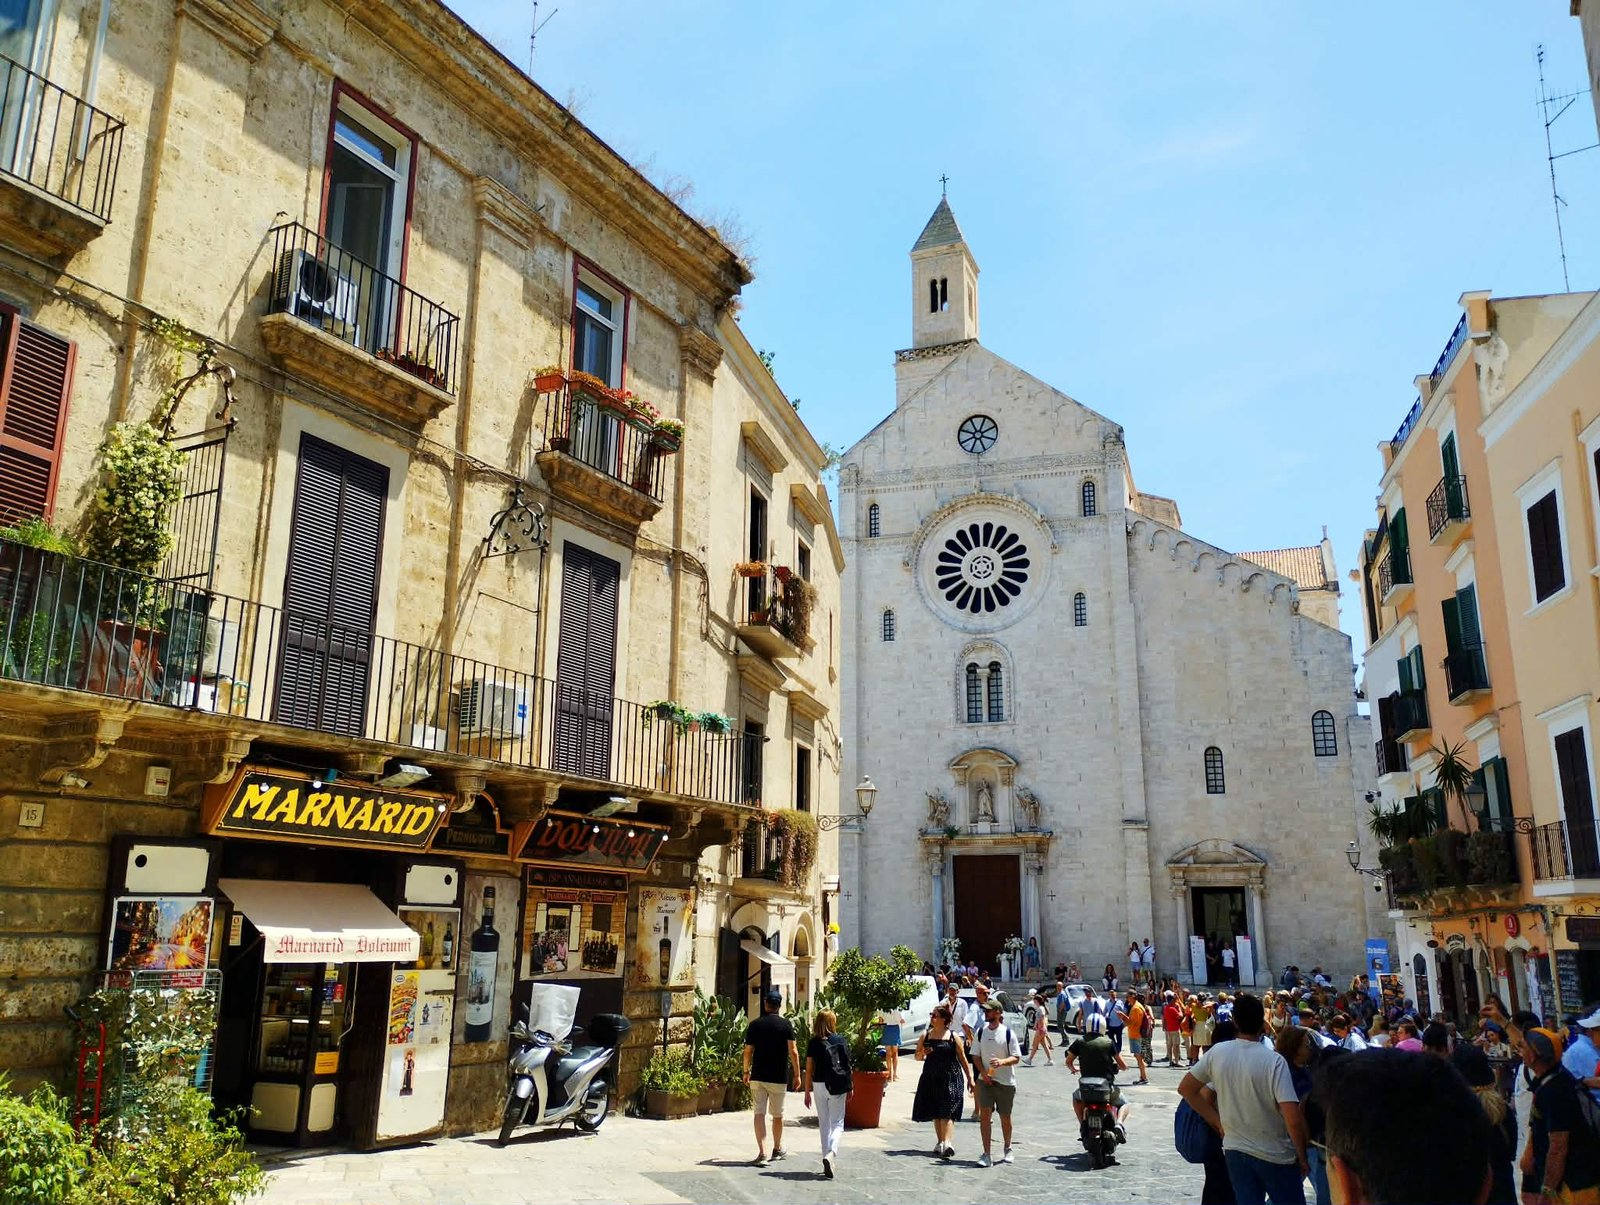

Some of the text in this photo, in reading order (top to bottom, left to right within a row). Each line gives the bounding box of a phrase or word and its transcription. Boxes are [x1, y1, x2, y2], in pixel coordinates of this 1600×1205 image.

[25, 809, 38, 821] 15
[232, 784, 435, 836] MARNARID
[537, 820, 655, 858] DOLCIUMI
[274, 935, 411, 954] Marnarid Dolciumi
